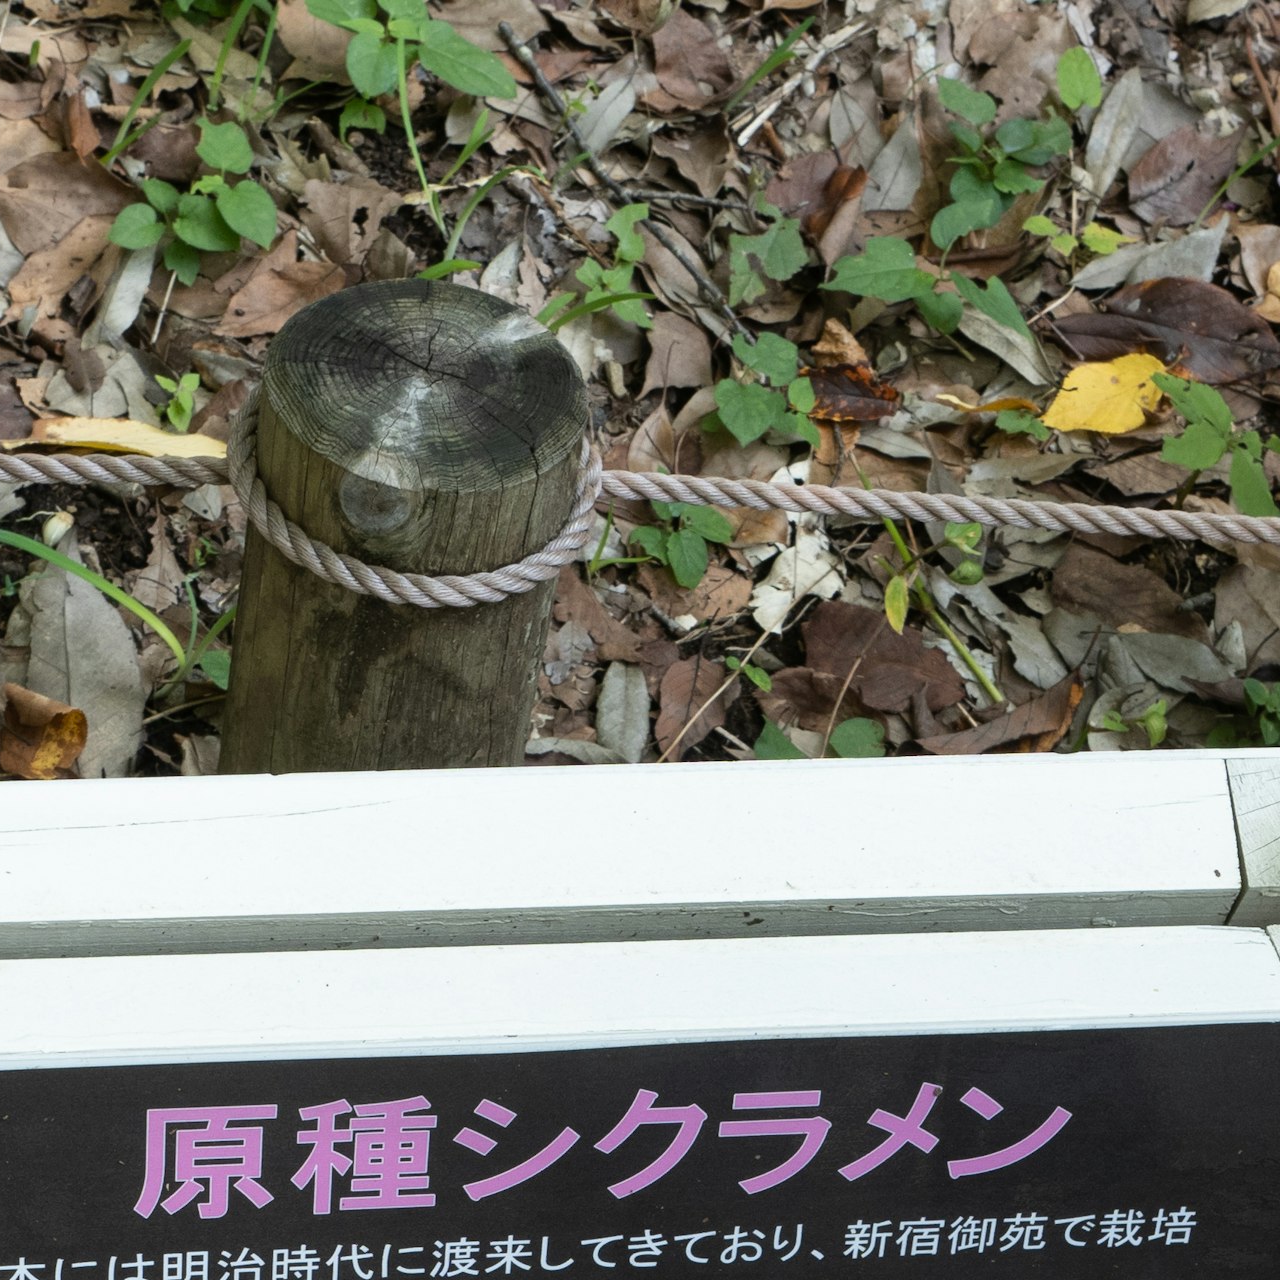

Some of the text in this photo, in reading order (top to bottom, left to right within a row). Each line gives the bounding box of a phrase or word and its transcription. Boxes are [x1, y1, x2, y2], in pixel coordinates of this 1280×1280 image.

[134, 1082, 1072, 1219] 原種シクラメン
